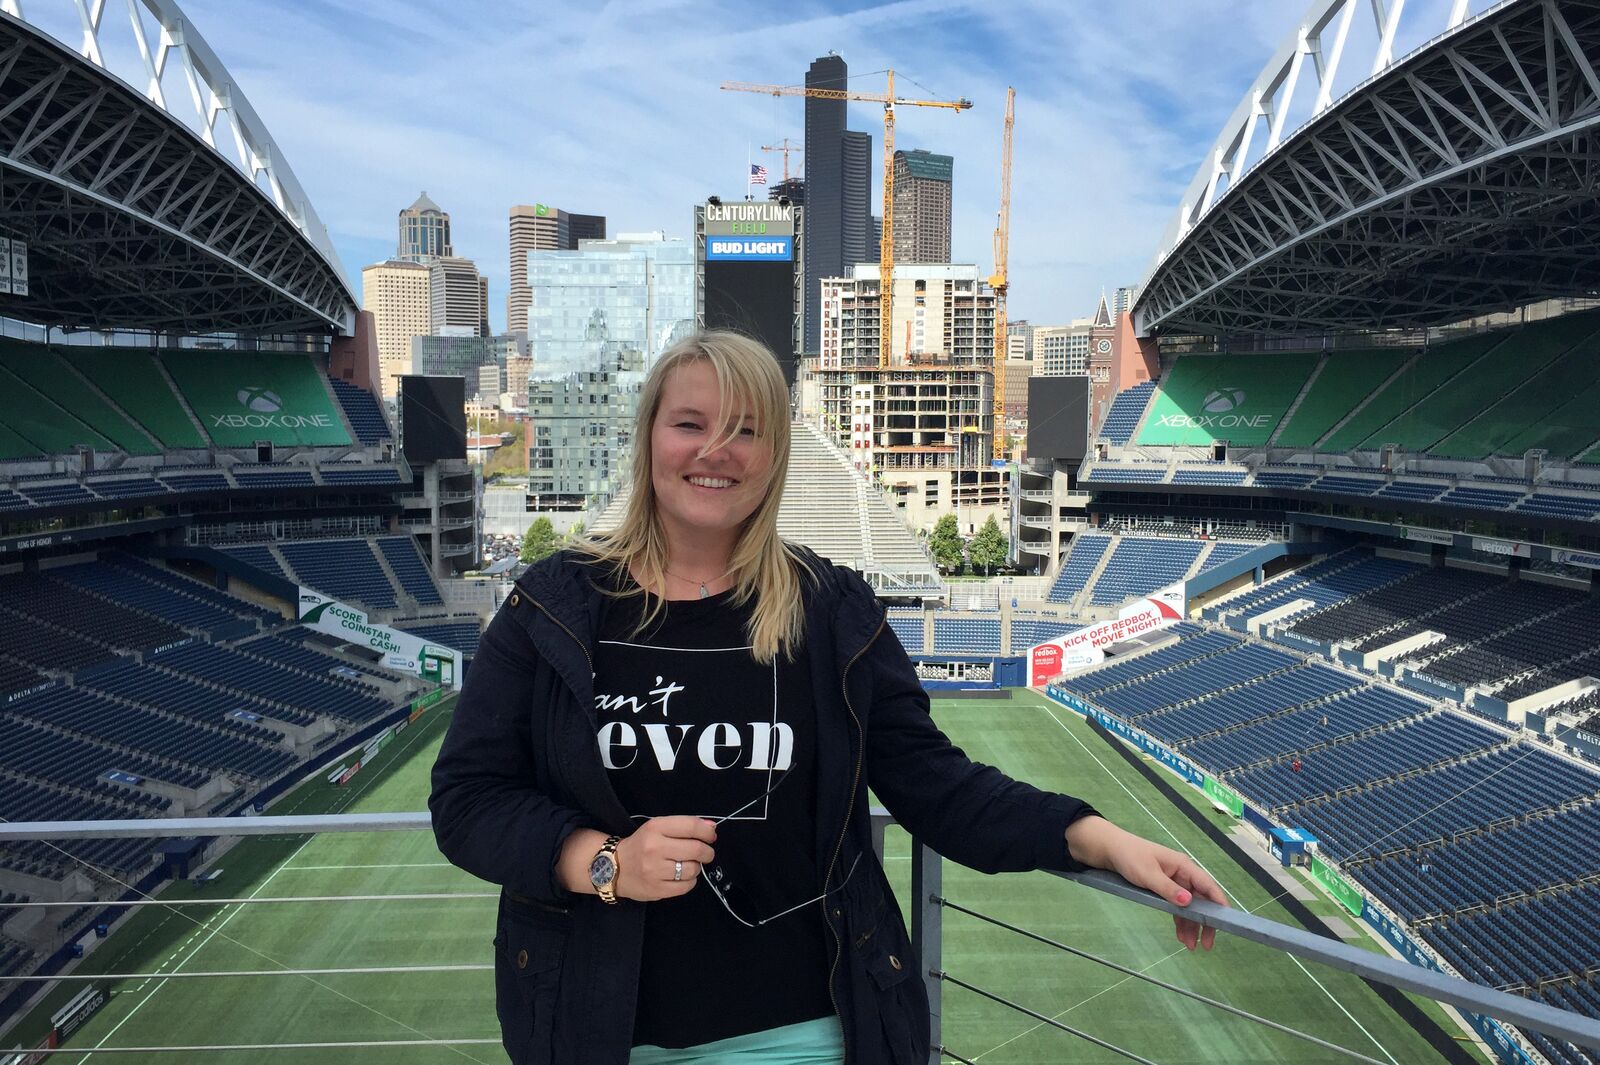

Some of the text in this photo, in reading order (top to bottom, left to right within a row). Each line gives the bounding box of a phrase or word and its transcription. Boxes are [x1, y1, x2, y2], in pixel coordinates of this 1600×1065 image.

[707, 204, 791, 221] CENTURYLINK
[732, 223, 767, 233] FIELD
[712, 242, 786, 254] BUD LIGHT
[210, 414, 334, 428] XBOX ONE
[1153, 414, 1272, 428] XBOX ONE
[1481, 542, 1514, 555] verizon
[329, 606, 363, 624] SCORE
[341, 619, 392, 642] COINSTAR
[1064, 610, 1153, 649] KICK OFF REDBOX
[1092, 617, 1162, 648] MOVIE NIGHT!
[370, 638, 401, 654] CASH!
[1416, 673, 1432, 683] DELTA
[14, 689, 31, 700] DELTA
[593, 673, 685, 717] an't
[597, 721, 794, 771] even
[79, 993, 104, 1020] adidas
